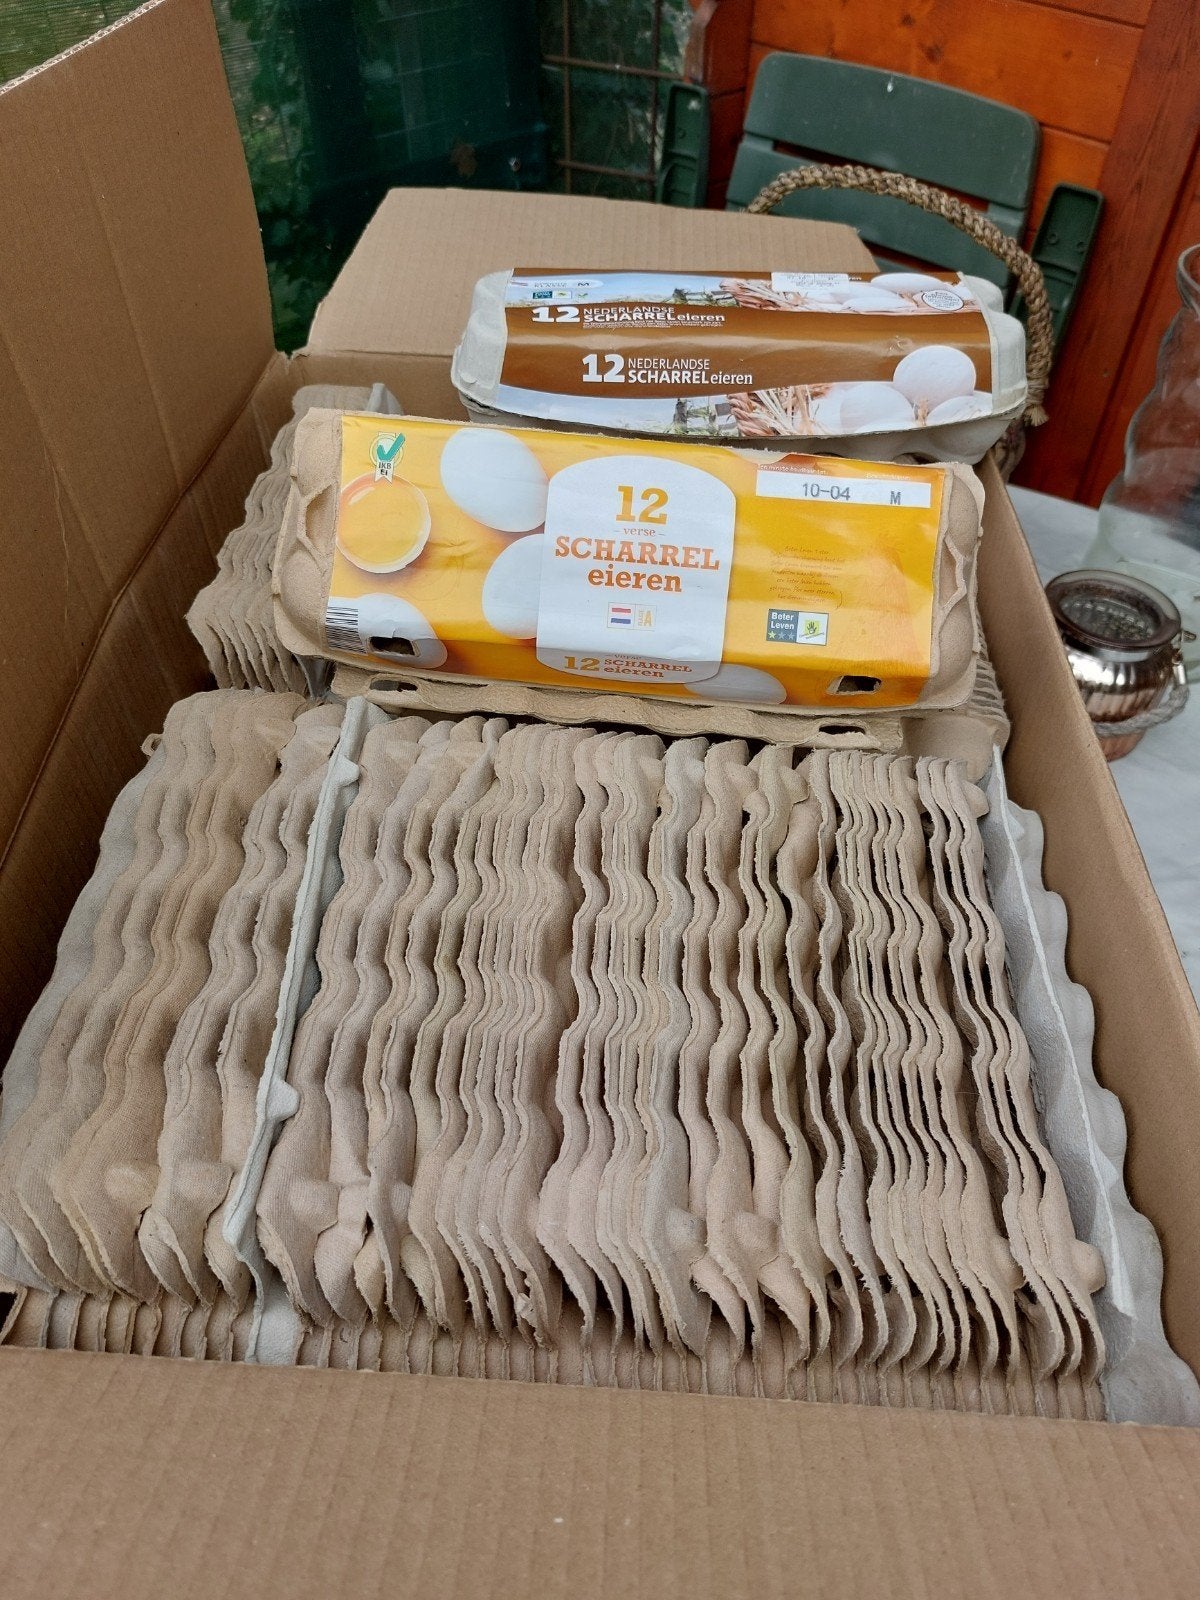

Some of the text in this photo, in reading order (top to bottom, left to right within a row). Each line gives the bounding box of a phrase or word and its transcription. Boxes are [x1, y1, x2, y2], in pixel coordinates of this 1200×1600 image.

[532, 306, 581, 323] 12
[583, 307, 675, 315] NEDERLANDSE
[583, 311, 726, 322] SCHARREL eieren
[582, 354, 625, 383] 12
[628, 358, 710, 370] NEDERLANDSE
[628, 370, 753, 386] SCHARREL eieren
[802, 483, 850, 500] 10-04
[890, 491, 901, 505] M
[615, 485, 669, 525] 12
[623, 527, 656, 537] verse
[555, 535, 720, 570] SCHARREL
[587, 563, 682, 593] eieren
[771, 612, 794, 621] Beter
[770, 621, 795, 630] Leven
[564, 656, 600, 672] 12
[604, 658, 693, 673] SCHARREL
[603, 666, 664, 678] eieren
